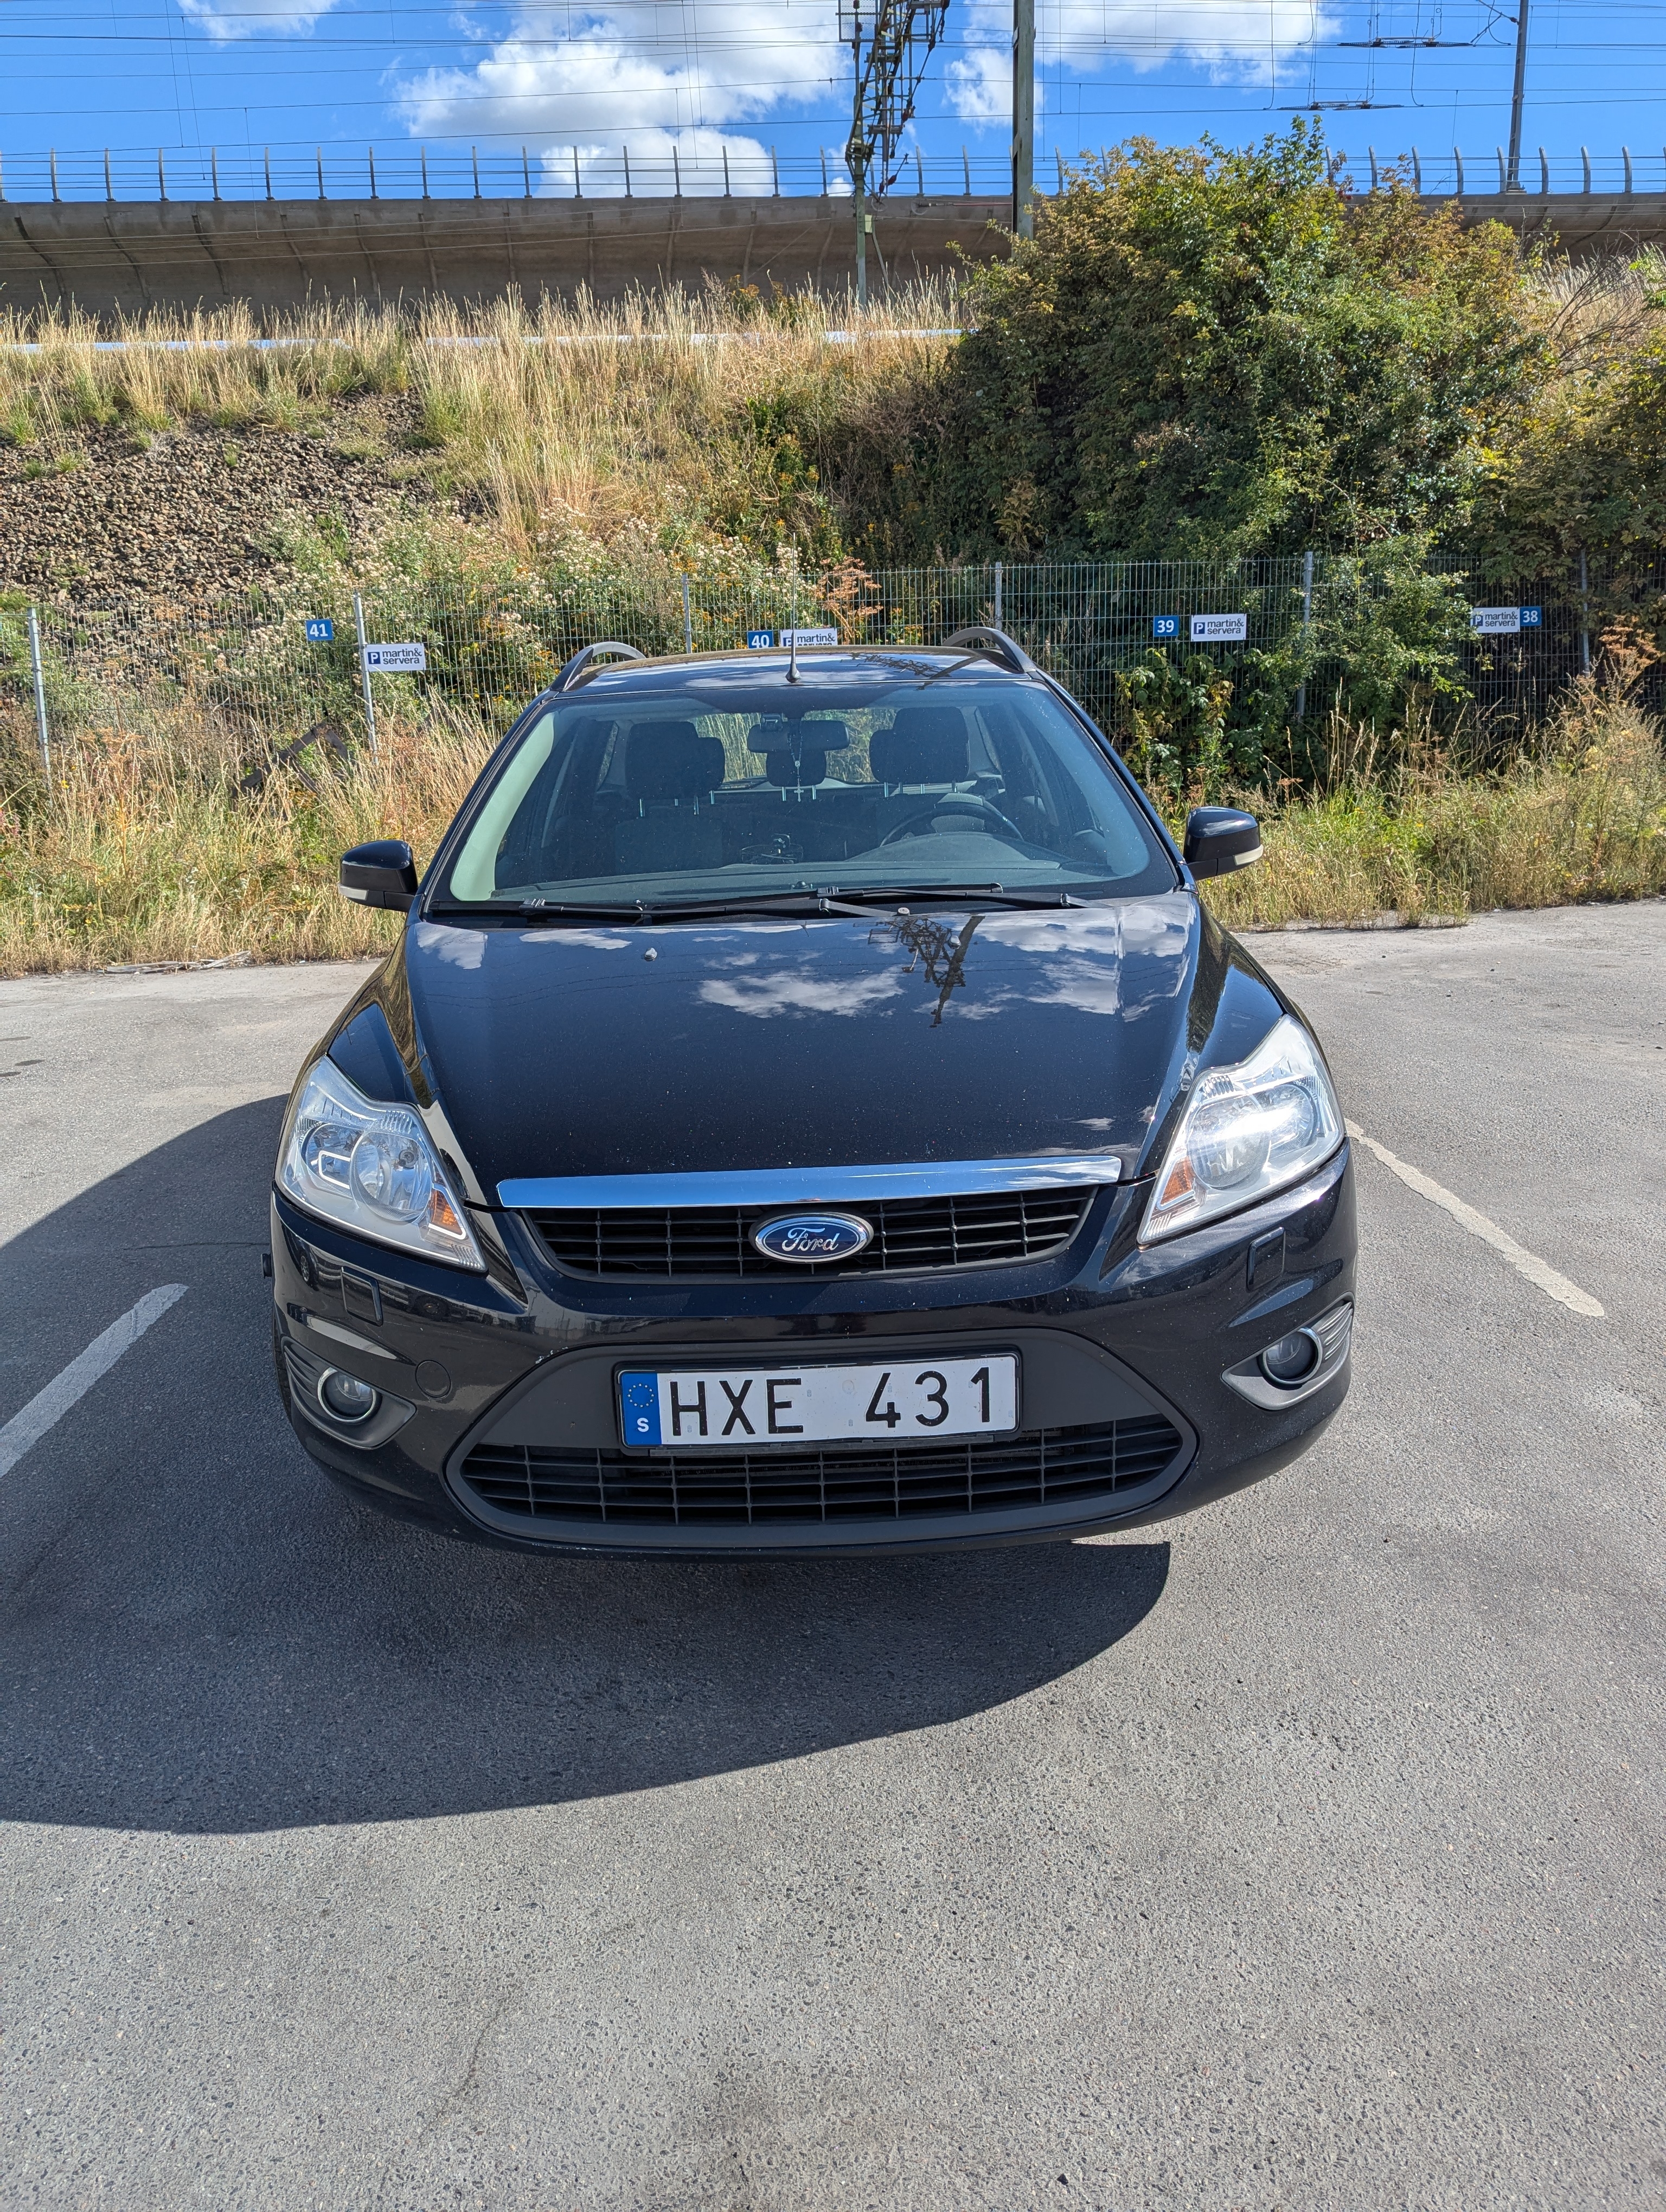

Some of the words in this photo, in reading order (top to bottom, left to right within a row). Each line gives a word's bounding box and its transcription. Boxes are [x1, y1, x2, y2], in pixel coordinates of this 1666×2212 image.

[1485, 611, 1518, 620] martin&
[1522, 610, 1538, 623] 38
[1157, 620, 1174, 633] 39
[1196, 623, 1203, 634] P
[1207, 618, 1244, 628] martin&
[309, 623, 329, 638] 41
[1207, 627, 1241, 635] servera
[751, 634, 770, 648] 40
[797, 633, 836, 643] martin&
[382, 647, 423, 658] martin&
[370, 653, 379, 664] P
[383, 657, 420, 665] servera
[781, 1227, 840, 1252] Ford
[669, 1378, 804, 1436] HXE
[866, 1367, 991, 1428] 431
[637, 1417, 649, 1432] S
